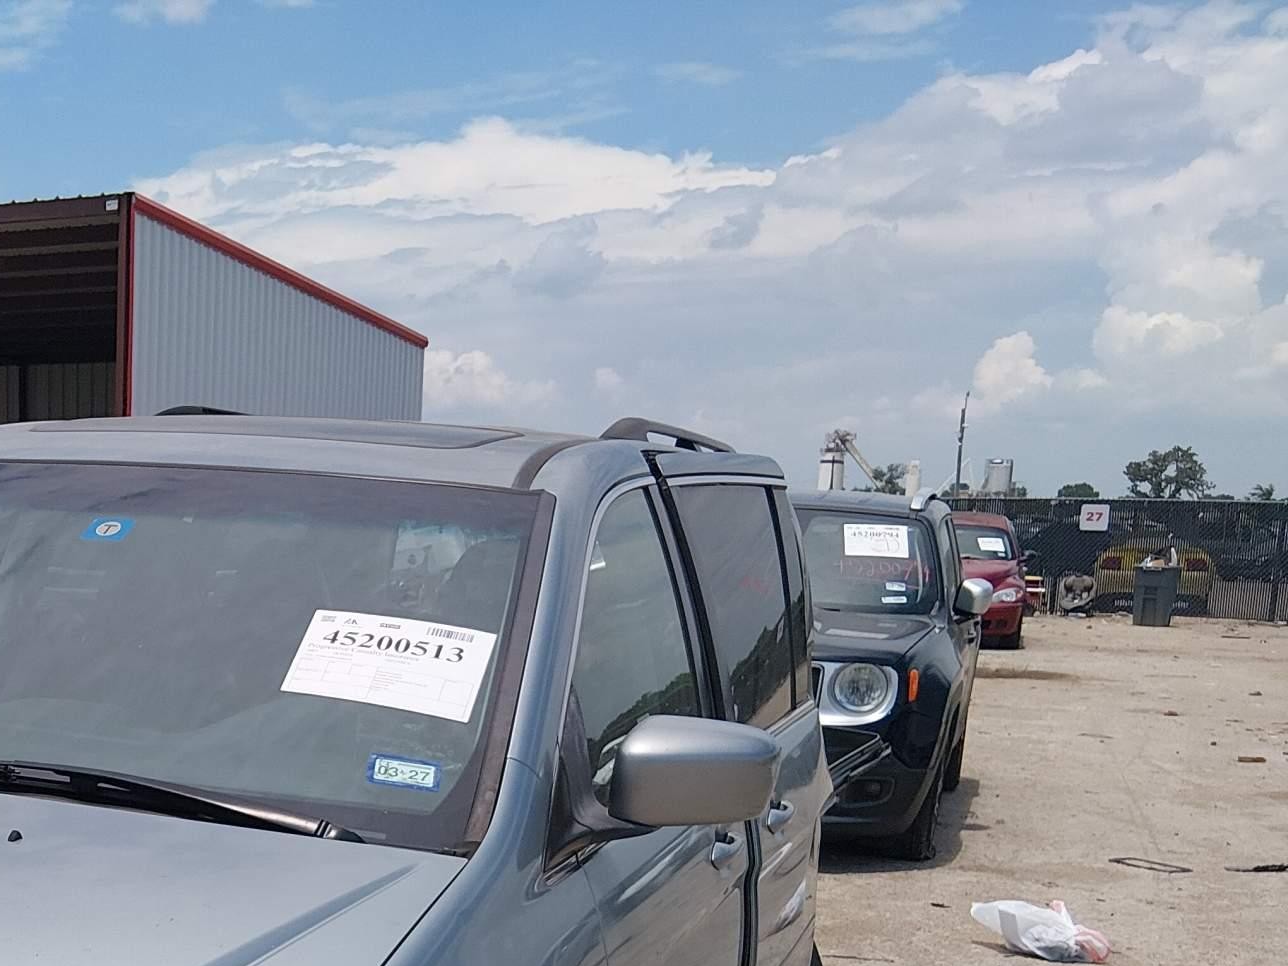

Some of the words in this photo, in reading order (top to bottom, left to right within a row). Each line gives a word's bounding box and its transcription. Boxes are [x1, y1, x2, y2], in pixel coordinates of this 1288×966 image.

[1086, 511, 1103, 522] 27
[103, 524, 119, 535] T
[323, 630, 464, 663] 45200513
